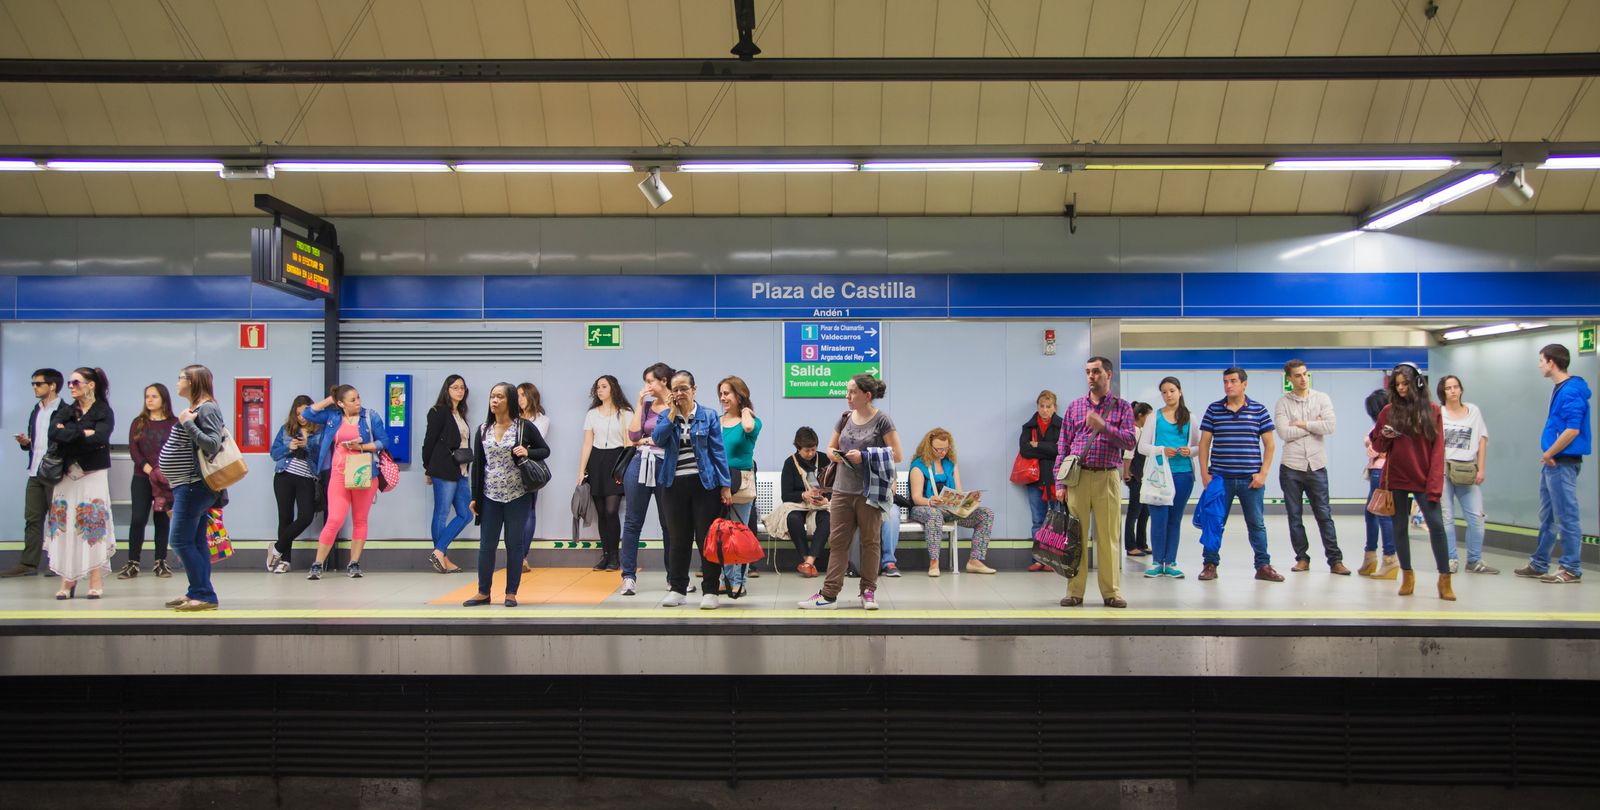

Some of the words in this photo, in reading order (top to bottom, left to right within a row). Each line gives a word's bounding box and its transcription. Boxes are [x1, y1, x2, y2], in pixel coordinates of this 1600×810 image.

[751, 282, 804, 299] Plaza
[810, 282, 835, 299] de
[841, 281, 916, 299] Castilla
[813, 308, 843, 317] Andén
[845, 308, 850, 317] 1
[805, 326, 813, 339] 1
[805, 346, 814, 359] 9
[820, 354, 843, 362] Arganda
[853, 354, 865, 362] Rey
[790, 364, 832, 377] Salida
